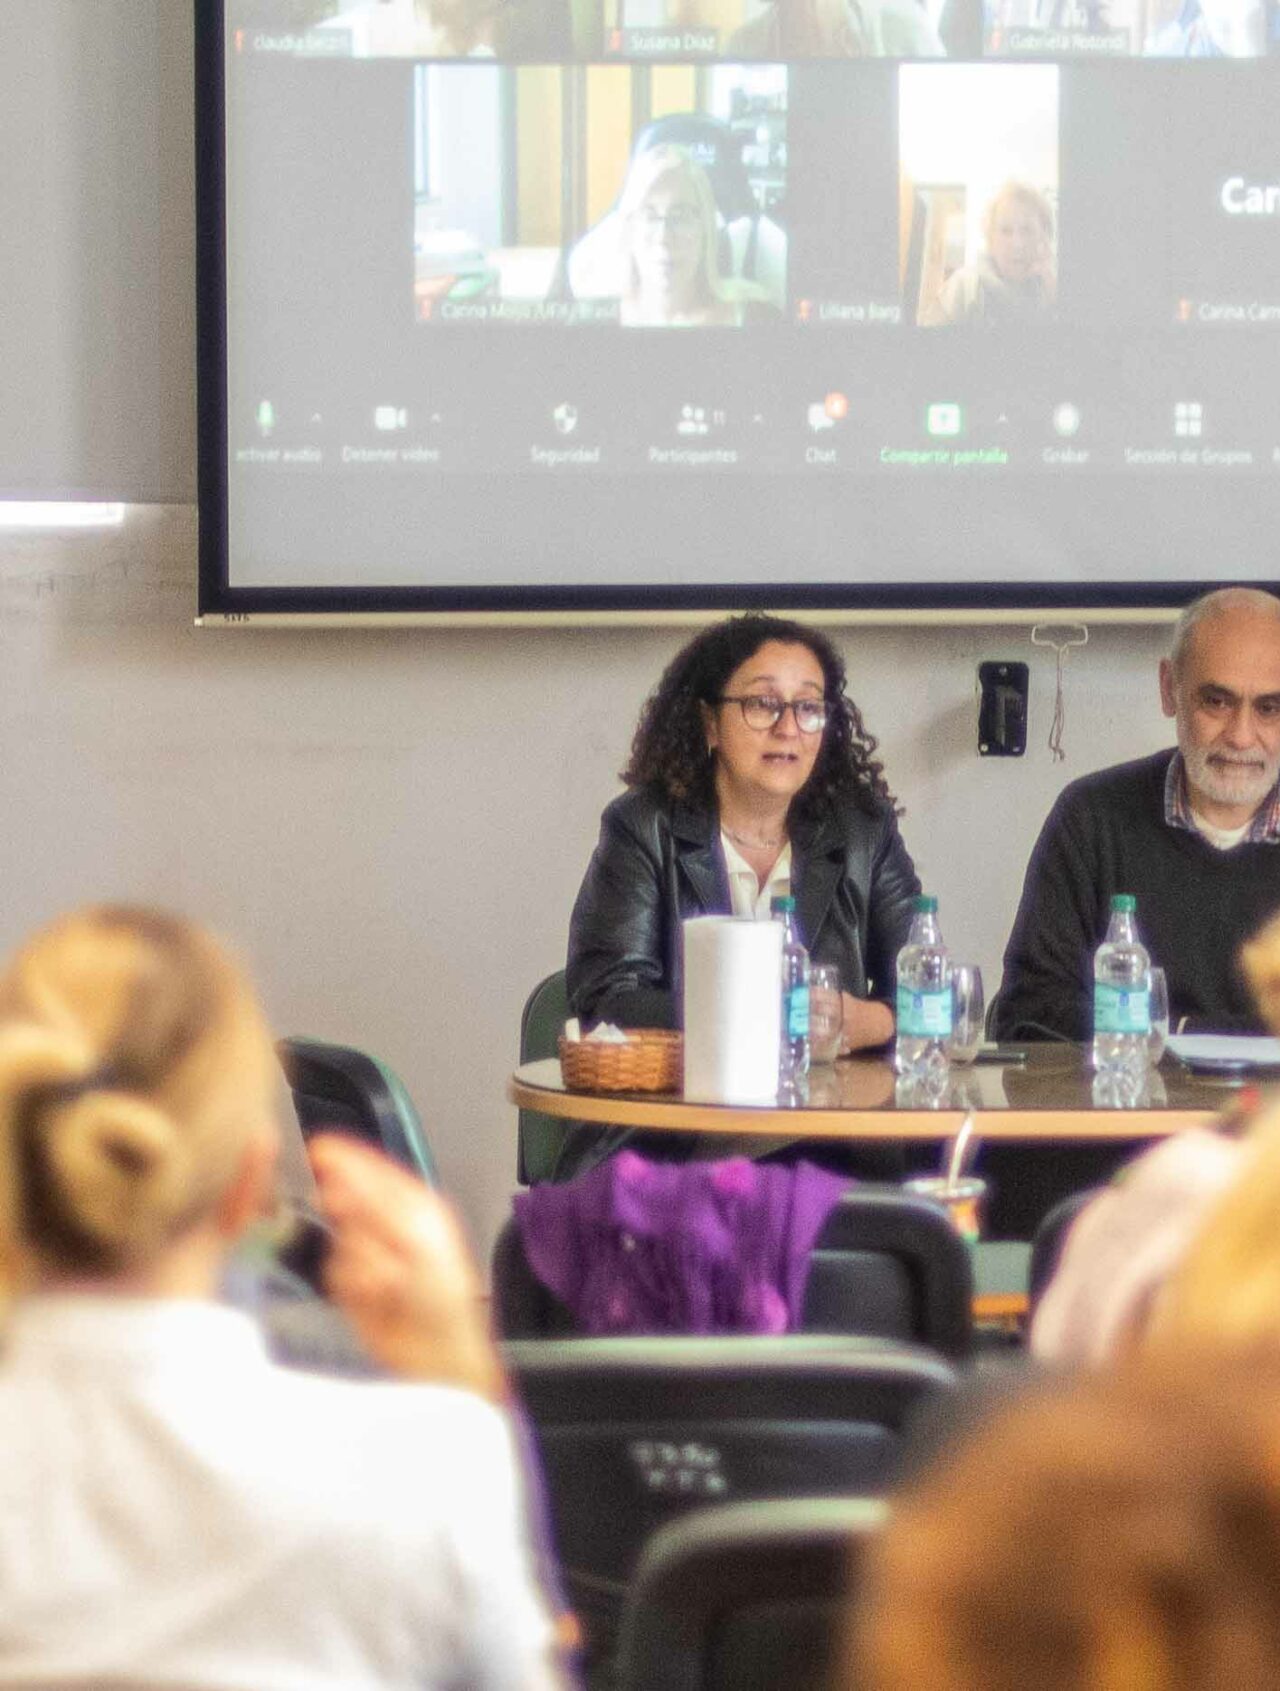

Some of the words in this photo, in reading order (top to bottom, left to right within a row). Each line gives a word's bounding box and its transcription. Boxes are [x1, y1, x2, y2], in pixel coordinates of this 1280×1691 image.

[1199, 303, 1245, 320] Carina
[530, 445, 600, 466] Seguridad
[648, 446, 738, 466] Participantes
[805, 446, 837, 464] Chat
[880, 446, 949, 466] Compartir
[953, 446, 1009, 466] pantalla
[1042, 446, 1090, 464] Grabar
[1182, 446, 1198, 464] de
